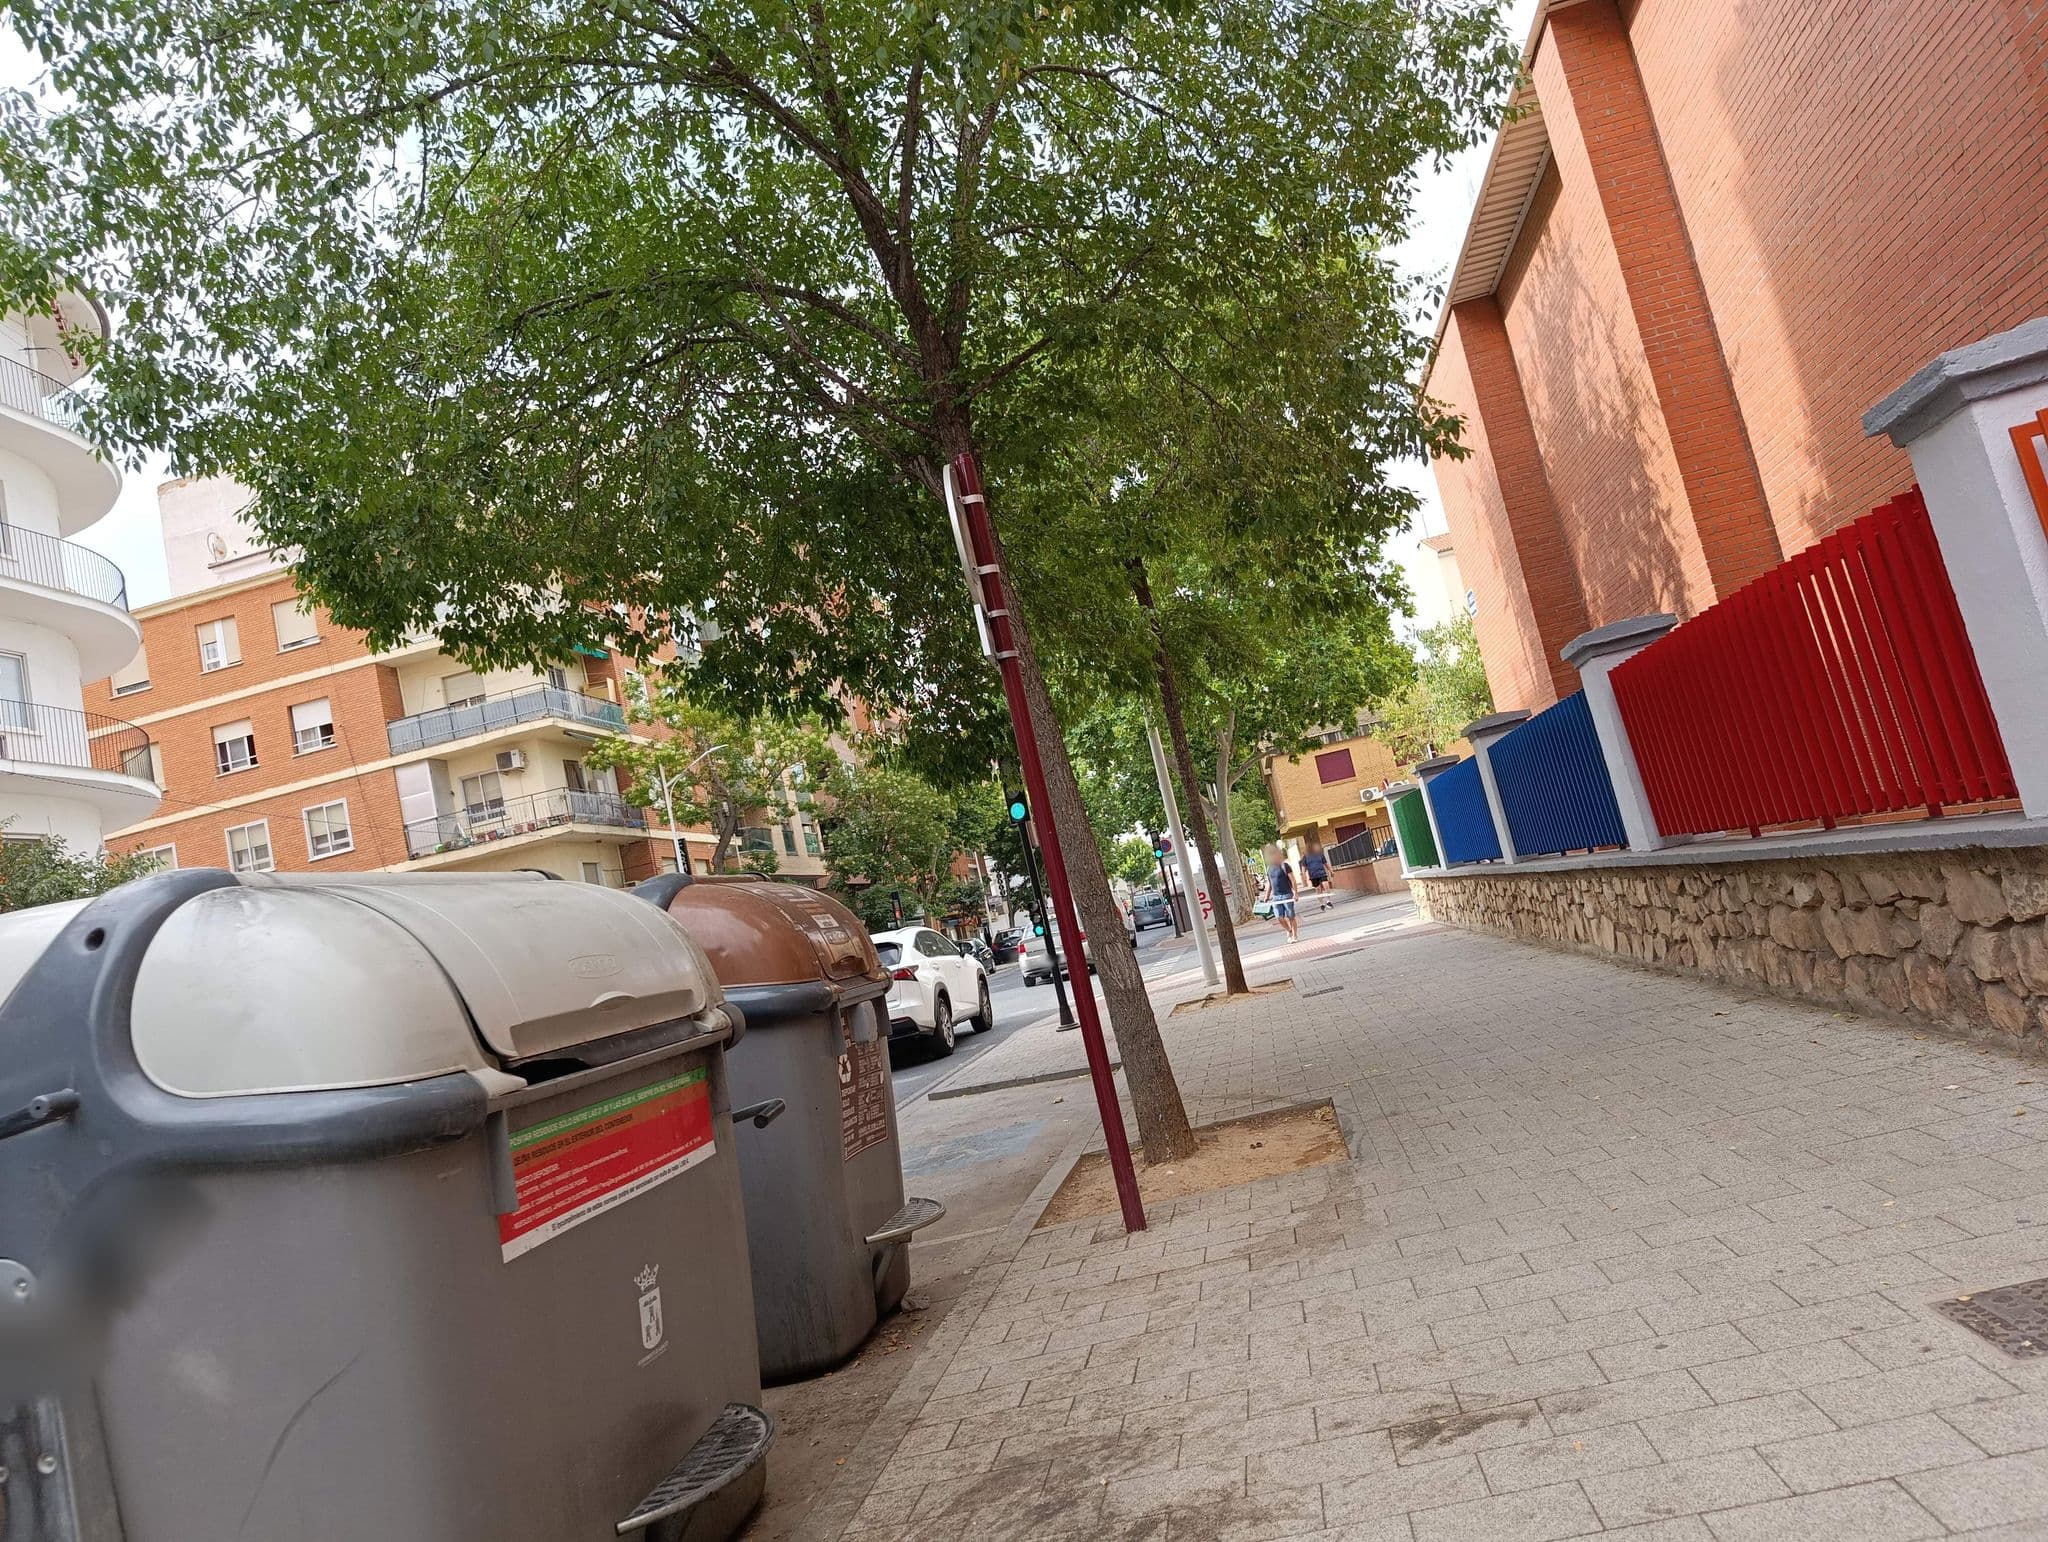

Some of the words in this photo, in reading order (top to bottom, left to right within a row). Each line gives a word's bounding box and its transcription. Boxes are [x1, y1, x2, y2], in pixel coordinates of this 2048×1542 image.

[571, 1127, 594, 1144] EXTERIOR
[603, 1112, 633, 1131] CONTENEDOR
[557, 1207, 586, 1229] incumplimiento
